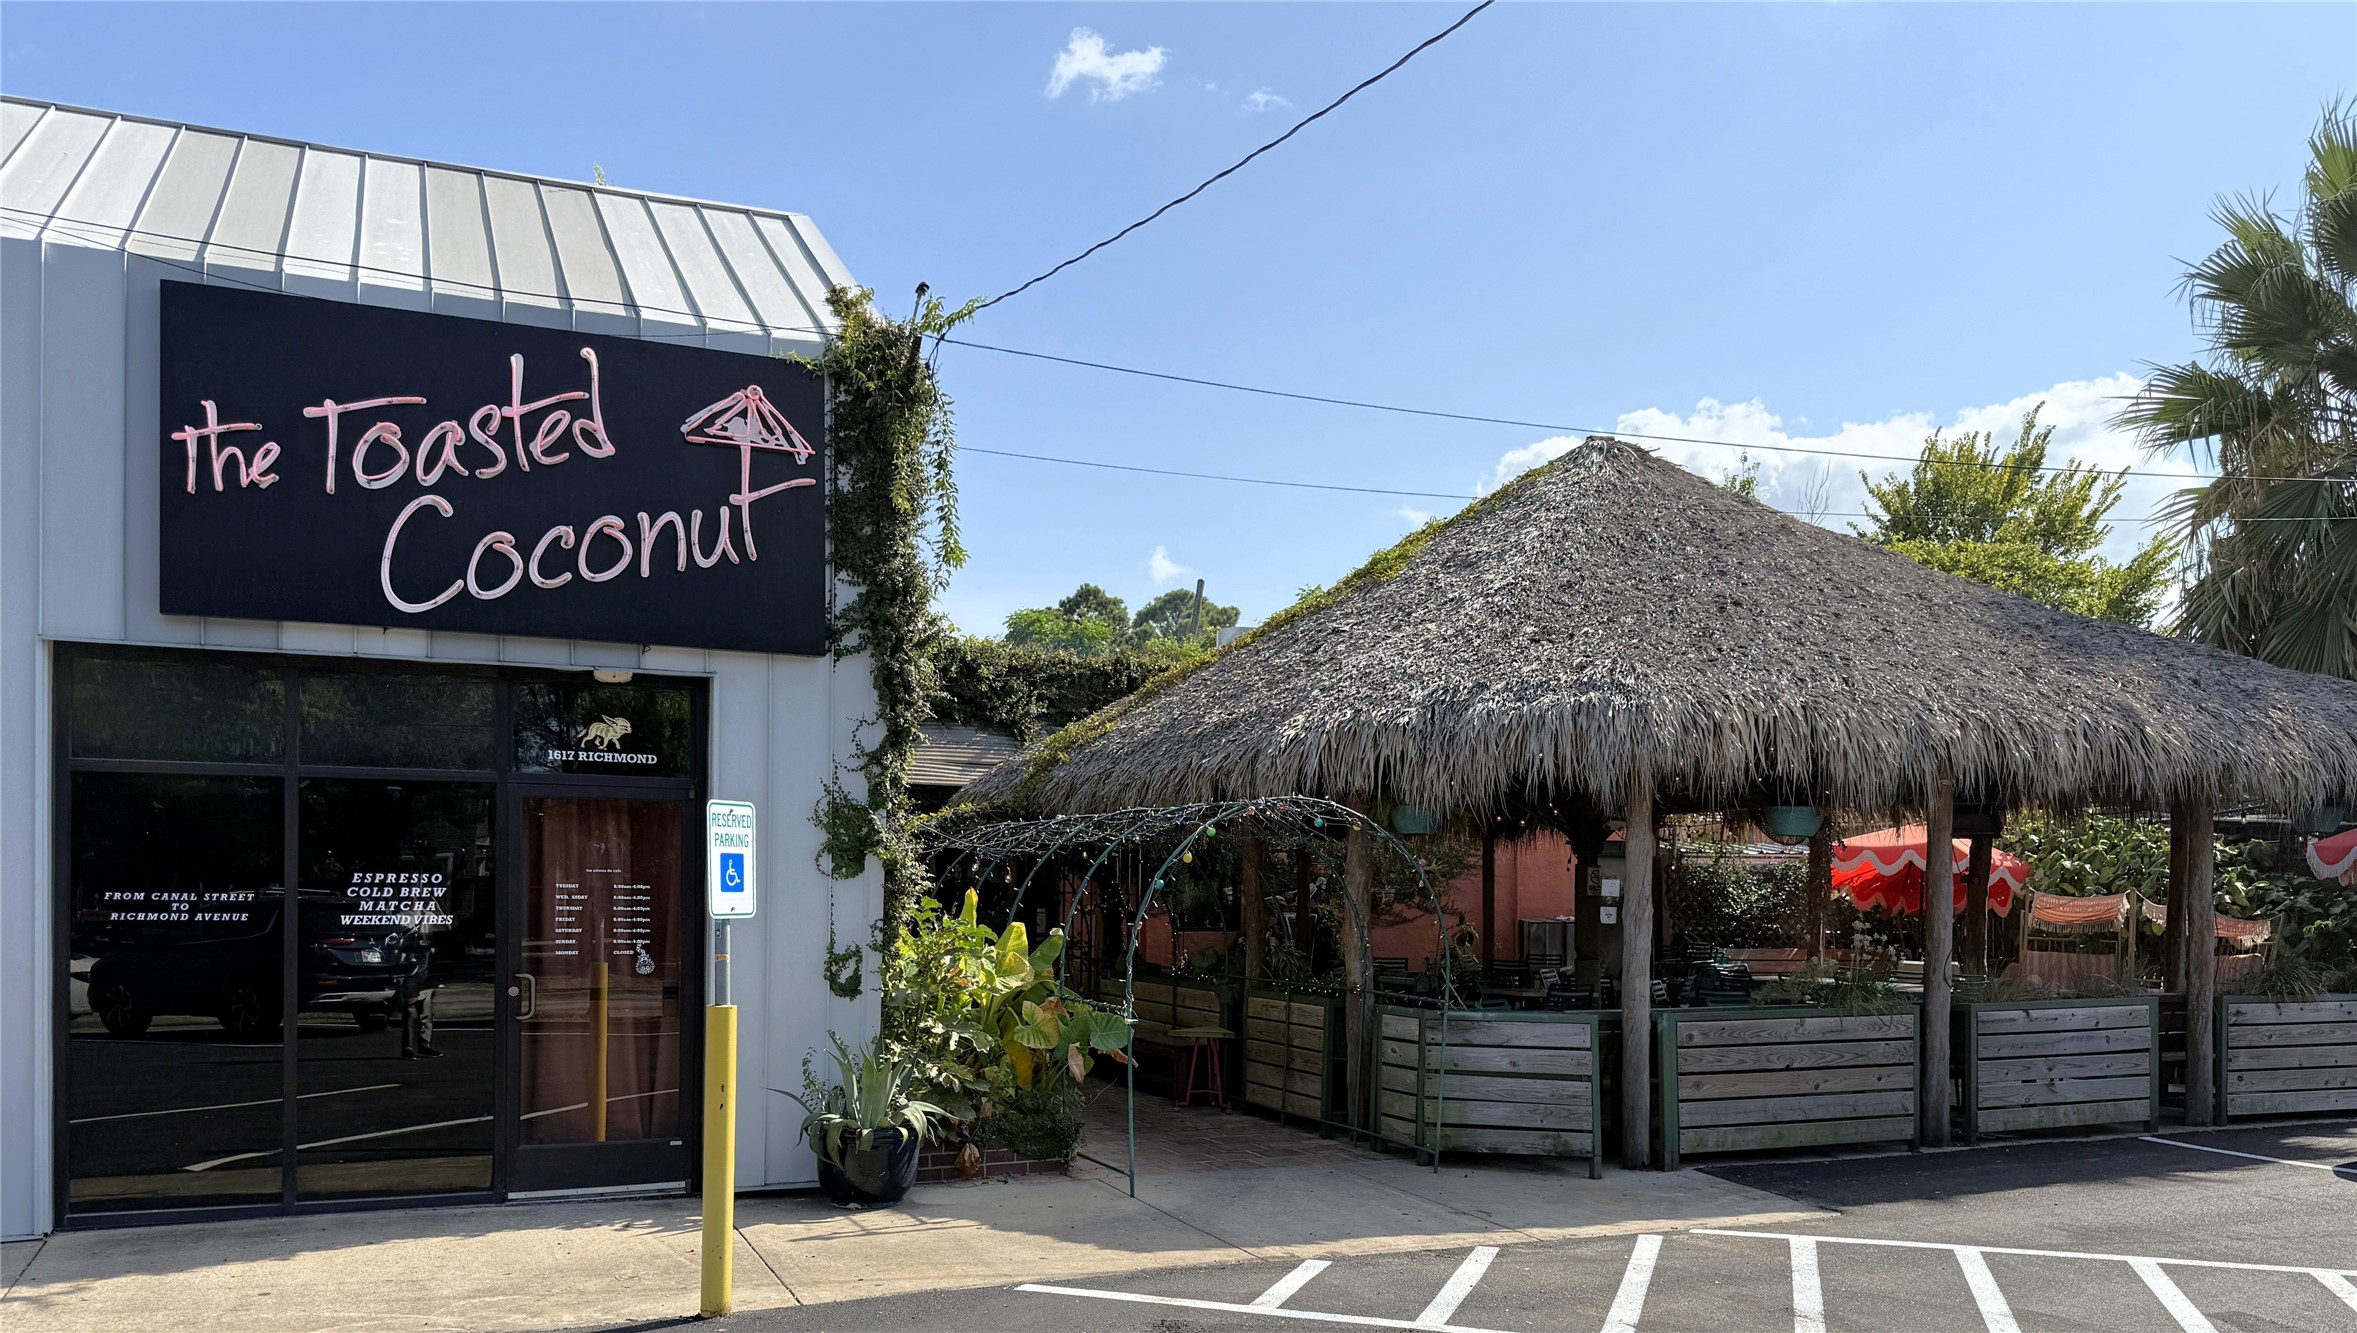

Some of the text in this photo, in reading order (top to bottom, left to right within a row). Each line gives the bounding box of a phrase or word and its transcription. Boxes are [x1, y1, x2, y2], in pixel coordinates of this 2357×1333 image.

[171, 347, 615, 495] the Toasted
[380, 444, 816, 613] Coconut
[548, 749, 658, 765] 1617 RICHMOND
[711, 812, 752, 829] RESERVED
[714, 832, 750, 848] PARKING
[351, 872, 443, 884] ESPRESSO
[103, 891, 255, 902] FROM CANAL STREET
[346, 886, 448, 898] COLD BREW
[171, 902, 190, 911] TO
[358, 900, 437, 912] MATCHA
[110, 912, 249, 922] RICHMOND AVENUE
[340, 914, 454, 926] WEEKEND VIBES
